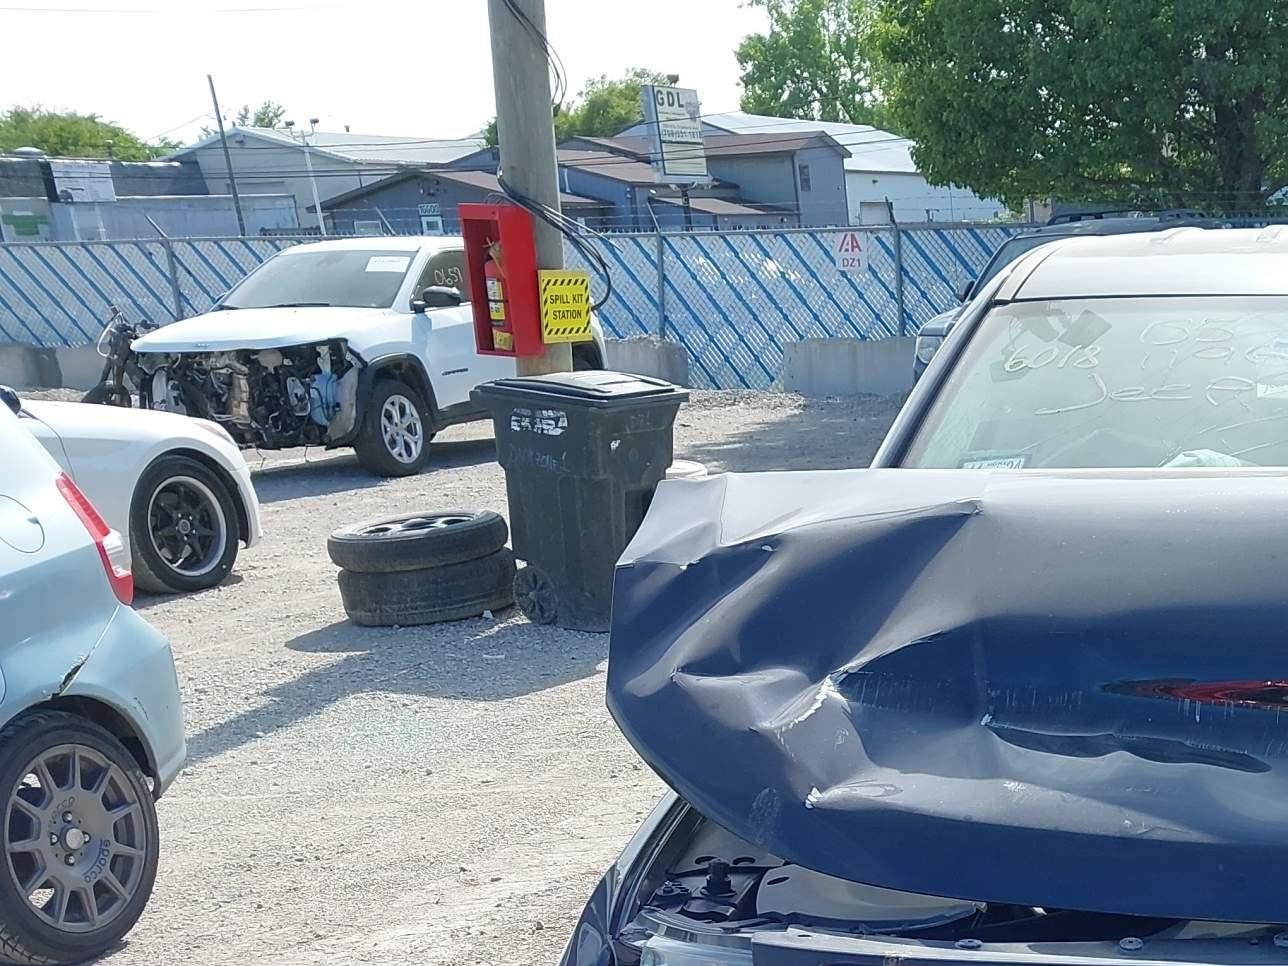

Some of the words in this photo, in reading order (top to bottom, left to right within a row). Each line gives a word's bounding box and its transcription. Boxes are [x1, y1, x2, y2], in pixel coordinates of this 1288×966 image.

[655, 90, 685, 108] GDL
[842, 258, 861, 267] DZ1
[549, 294, 570, 304] SPILL
[572, 294, 583, 304] KIT
[552, 310, 582, 320] STATION
[1004, 345, 1103, 373] 6018
[84, 839, 111, 884] sparco
